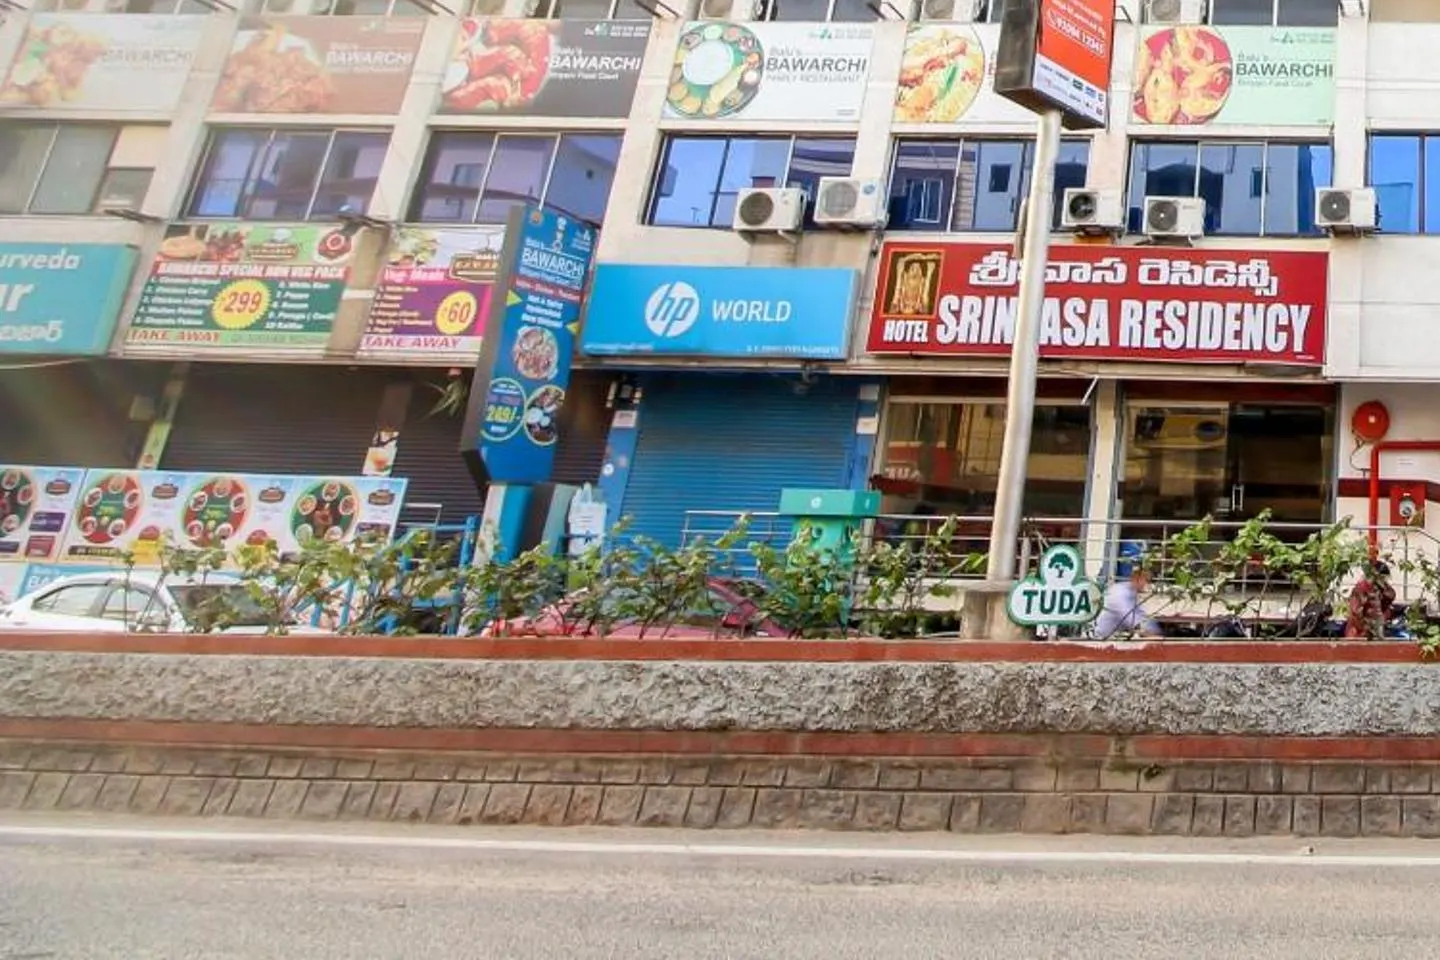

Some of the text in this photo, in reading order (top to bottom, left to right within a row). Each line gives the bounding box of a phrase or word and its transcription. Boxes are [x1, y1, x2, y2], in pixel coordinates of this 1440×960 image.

[327, 50, 423, 67] BAWARCHI
[549, 55, 642, 71] BAWARCHI
[766, 57, 866, 73] BAWARCHI
[1236, 62, 1334, 78] BAWARCHI
[521, 247, 584, 276] BAWARCHI
[223, 292, 262, 314] 299
[448, 302, 471, 323] 60
[645, 281, 791, 337] hp WORLD
[883, 295, 1312, 352] HOTEL SRINASA RESIDENCY
[131, 329, 170, 341] TAKE
[178, 331, 219, 342] AWAY
[364, 336, 461, 348] TAKE AWAY
[1023, 590, 1091, 614] TUDA
